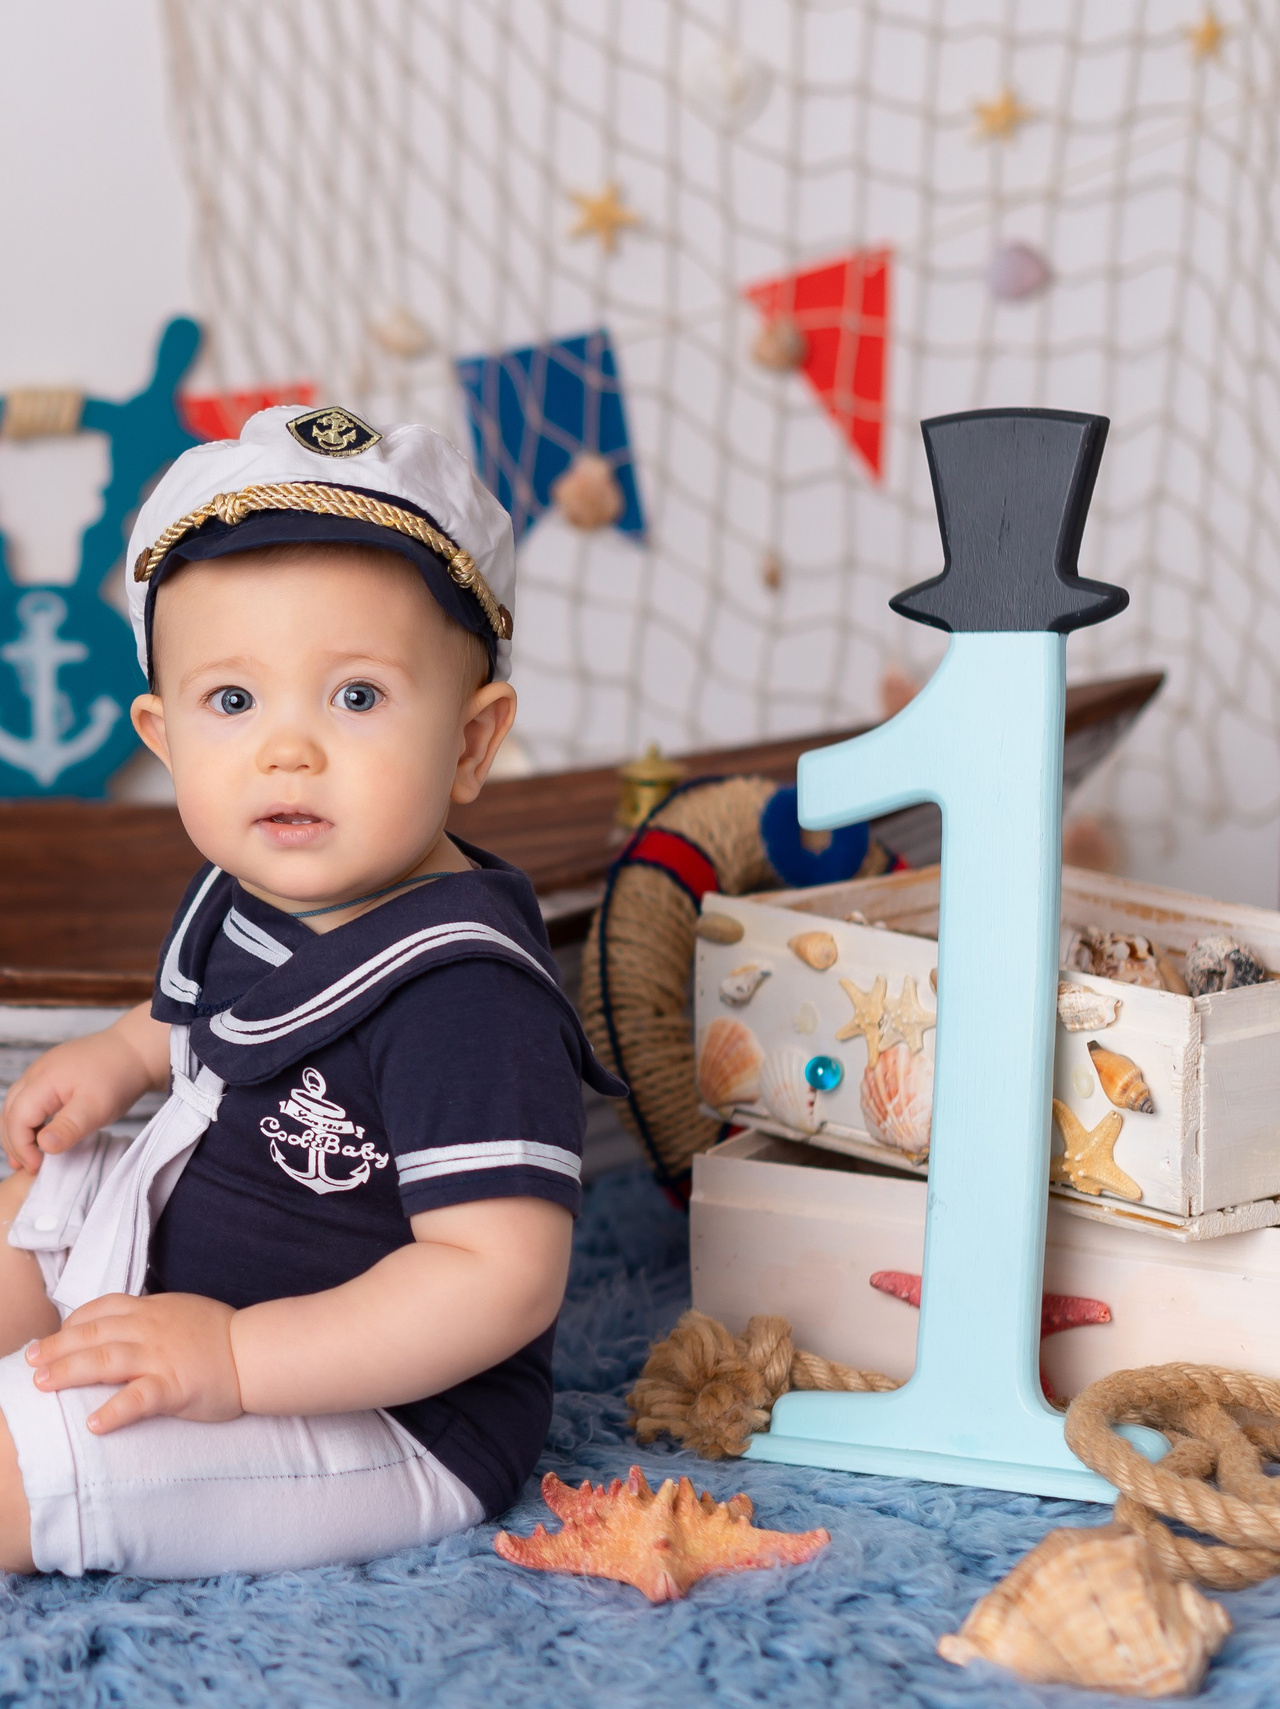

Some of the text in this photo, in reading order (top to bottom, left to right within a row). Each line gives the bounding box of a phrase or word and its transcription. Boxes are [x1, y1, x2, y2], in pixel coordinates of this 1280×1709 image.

[259, 1116, 389, 1169] Cool Baby
[746, 631, 1171, 1504] 1
